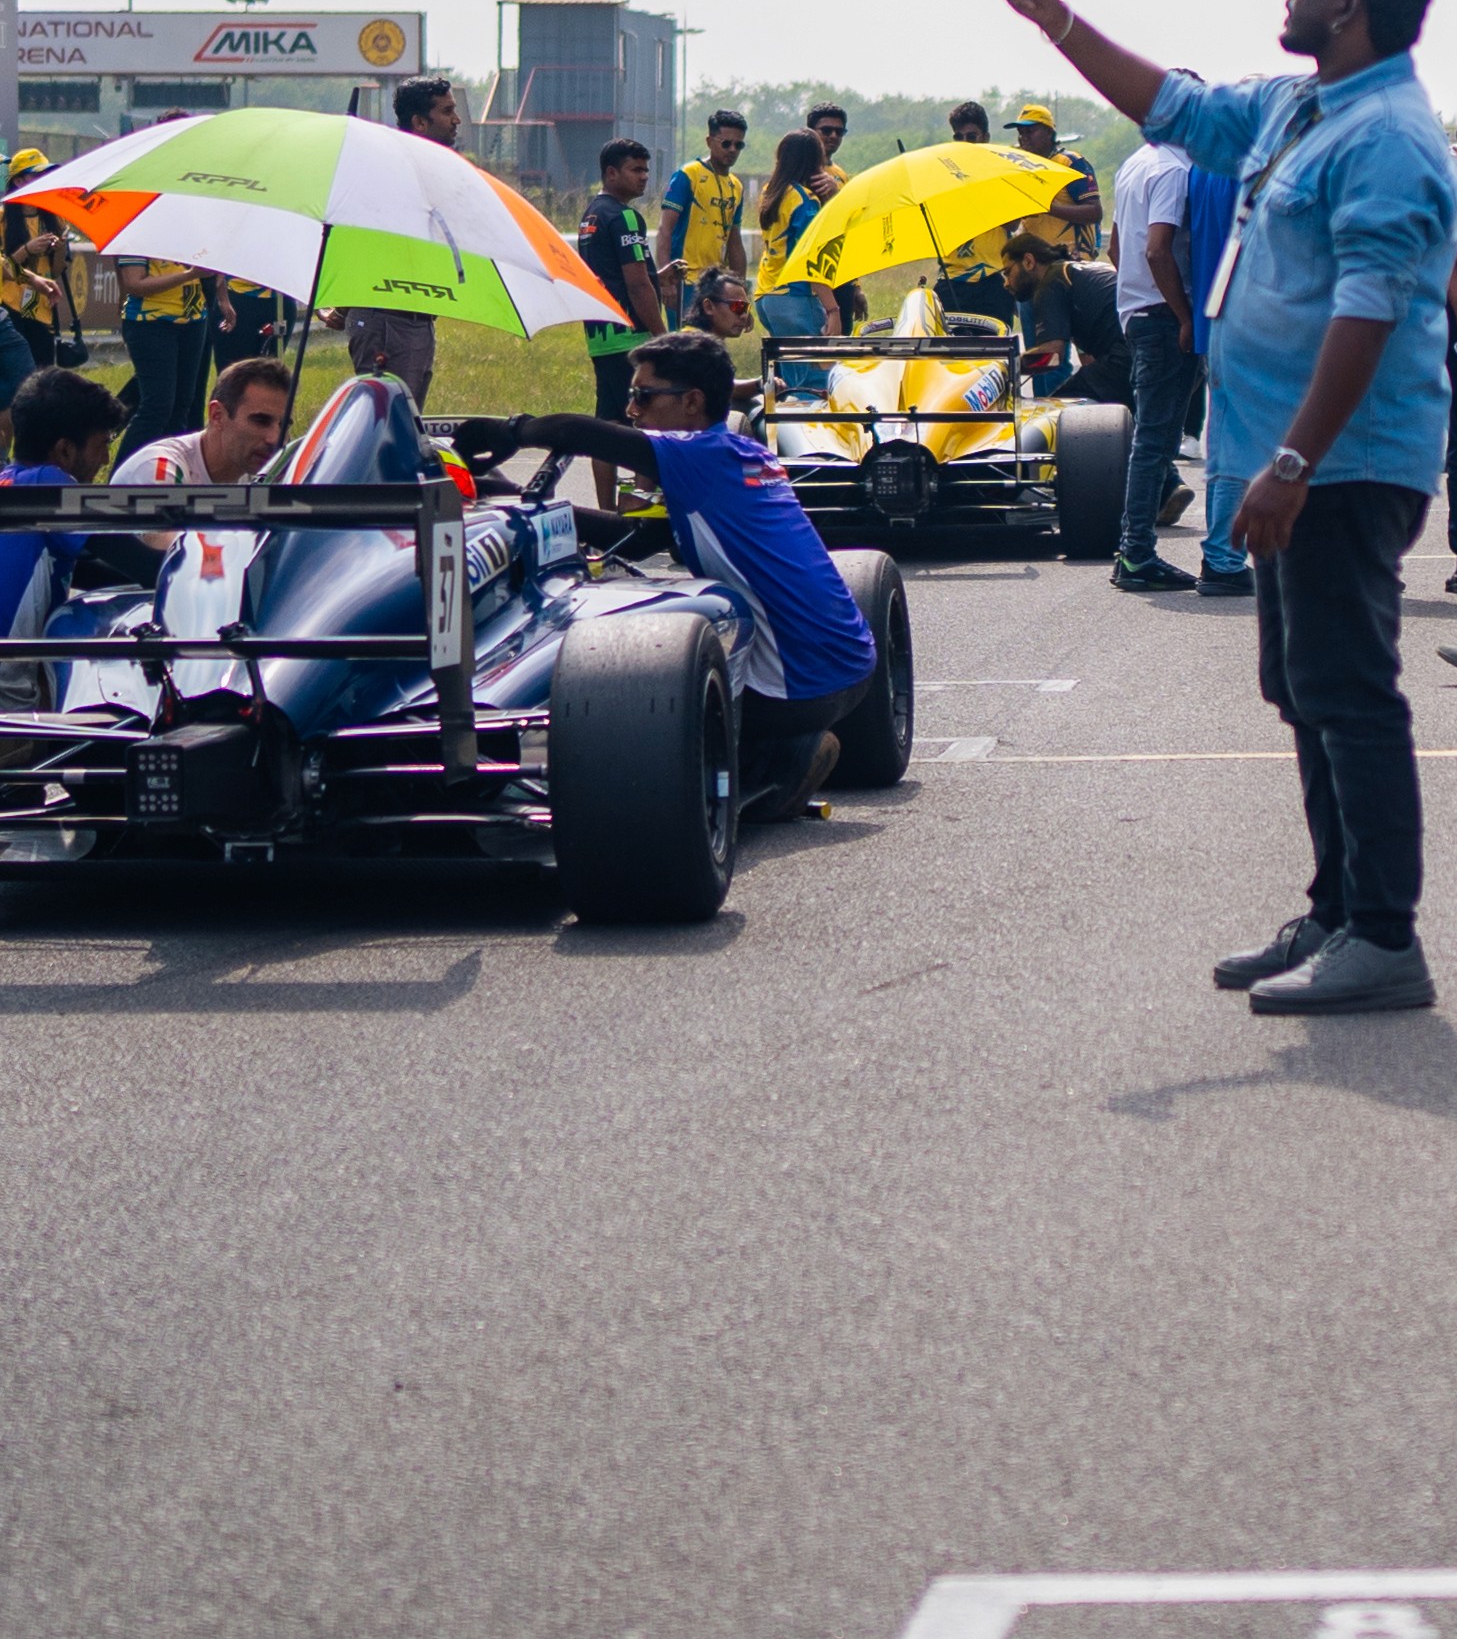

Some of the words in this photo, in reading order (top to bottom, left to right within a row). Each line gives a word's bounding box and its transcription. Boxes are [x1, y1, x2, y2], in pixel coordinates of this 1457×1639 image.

[211, 30, 318, 55] MIKA
[18, 47, 87, 65] RENA
[177, 172, 267, 192] RPPL
[965, 377, 1000, 411] Mobil
[466, 542, 493, 586] bil
